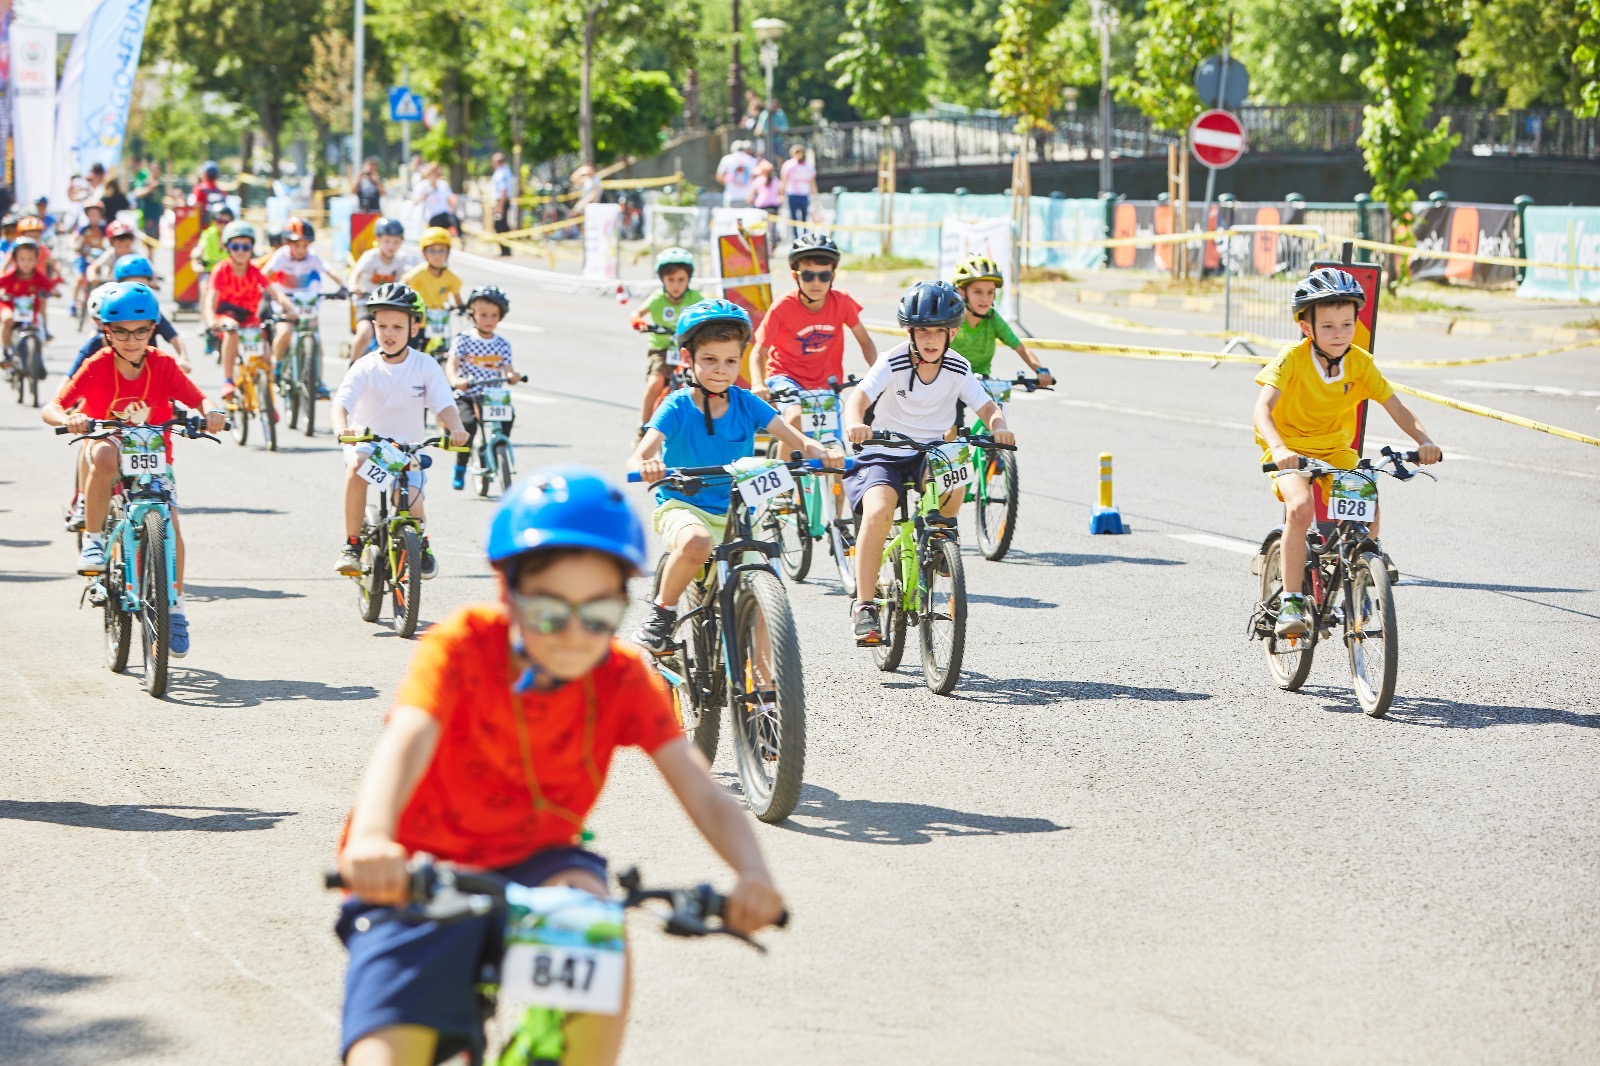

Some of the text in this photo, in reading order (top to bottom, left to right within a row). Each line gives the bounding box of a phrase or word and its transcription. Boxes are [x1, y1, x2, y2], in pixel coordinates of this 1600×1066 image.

[490, 407, 506, 417] 201
[812, 414, 827, 427] 32
[131, 454, 158, 470] 859
[366, 464, 388, 484] 123
[750, 470, 782, 496] 128
[943, 466, 968, 488] 890
[1337, 499, 1367, 517] 628
[532, 954, 597, 992] 847
